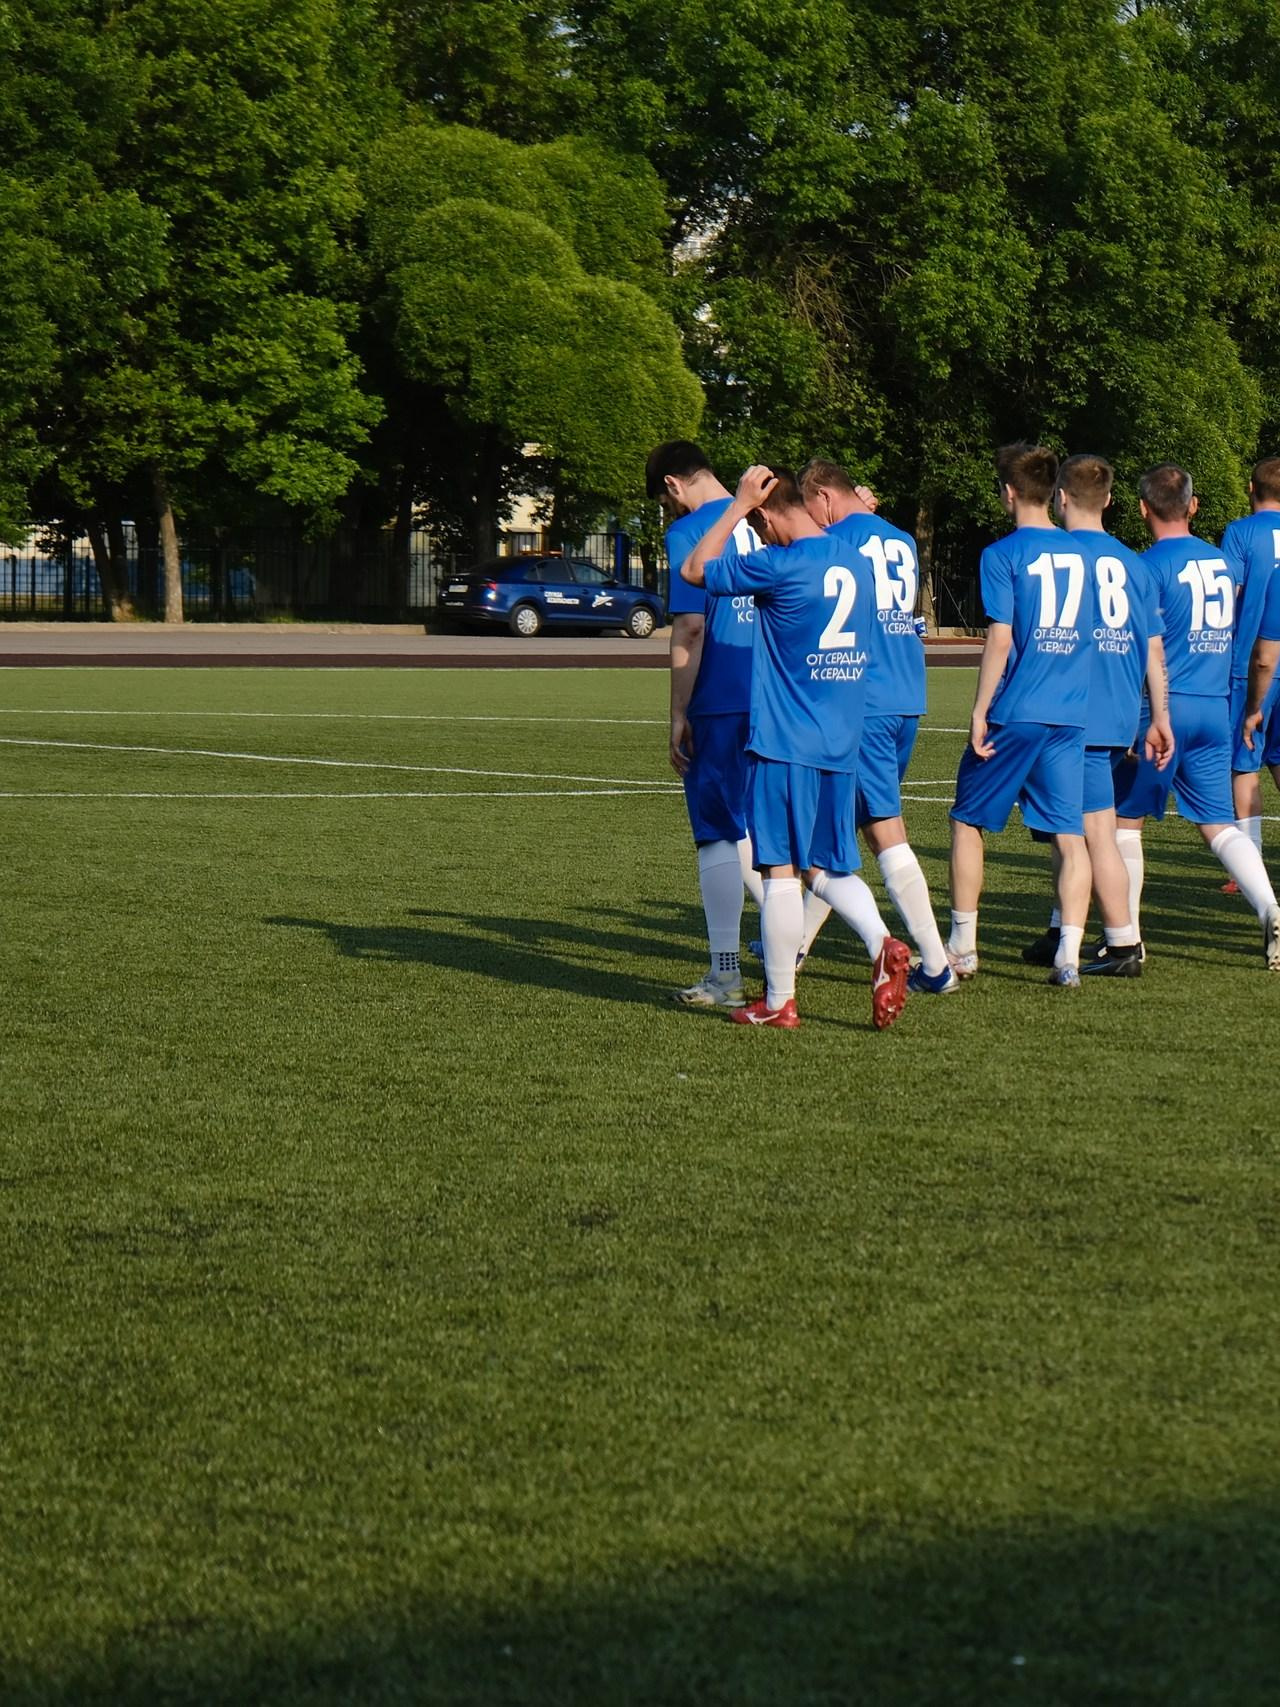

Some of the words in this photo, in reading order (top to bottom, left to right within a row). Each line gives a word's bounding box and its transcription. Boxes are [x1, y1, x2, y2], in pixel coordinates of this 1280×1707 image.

[859, 535, 916, 614] 13
[1027, 552, 1085, 628] 17
[1096, 556, 1130, 629] 8
[1177, 558, 1234, 631] 15
[819, 566, 856, 650] 2
[888, 622, 916, 636] СЕРД
[1107, 628, 1135, 641] СДЦА
[1200, 630, 1232, 642] СЕЦА
[1197, 641, 1229, 654] СЕЦУ
[806, 653, 824, 666] ОТ
[825, 651, 867, 665] СЕРДЦА
[810, 668, 819, 680] К
[820, 667, 863, 681] СЕРДЦУ
